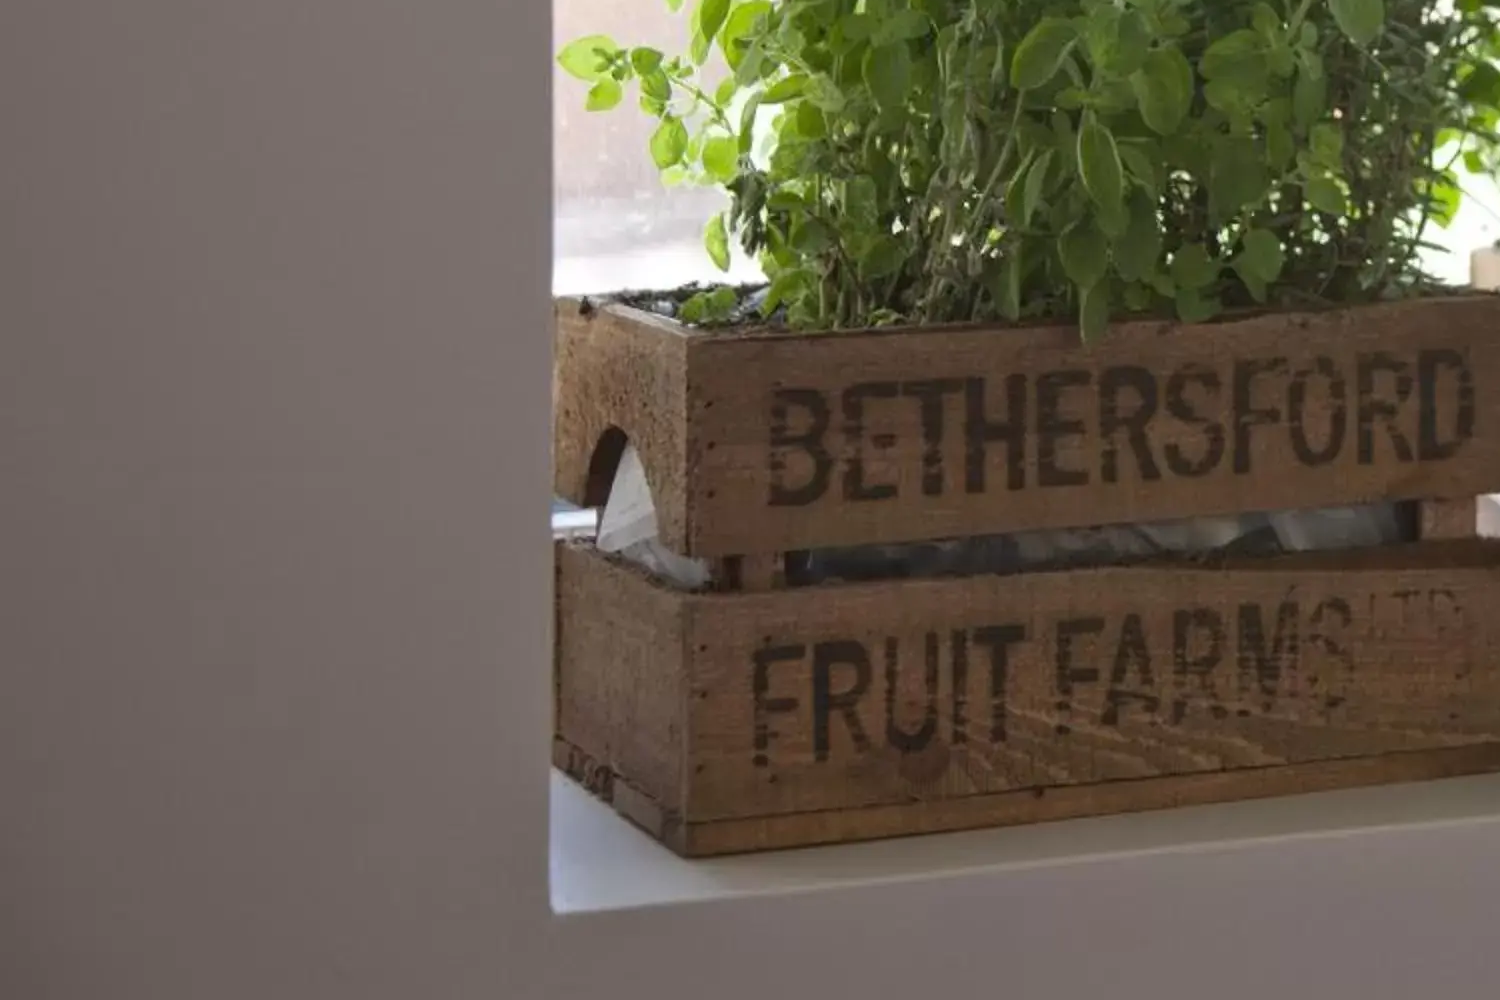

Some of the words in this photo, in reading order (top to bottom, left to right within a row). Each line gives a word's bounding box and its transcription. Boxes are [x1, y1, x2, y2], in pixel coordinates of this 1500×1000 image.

[768, 349, 1475, 507] BETHERSFORD
[752, 625, 1030, 769] FRUIT
[1056, 598, 1353, 737] FARMS
